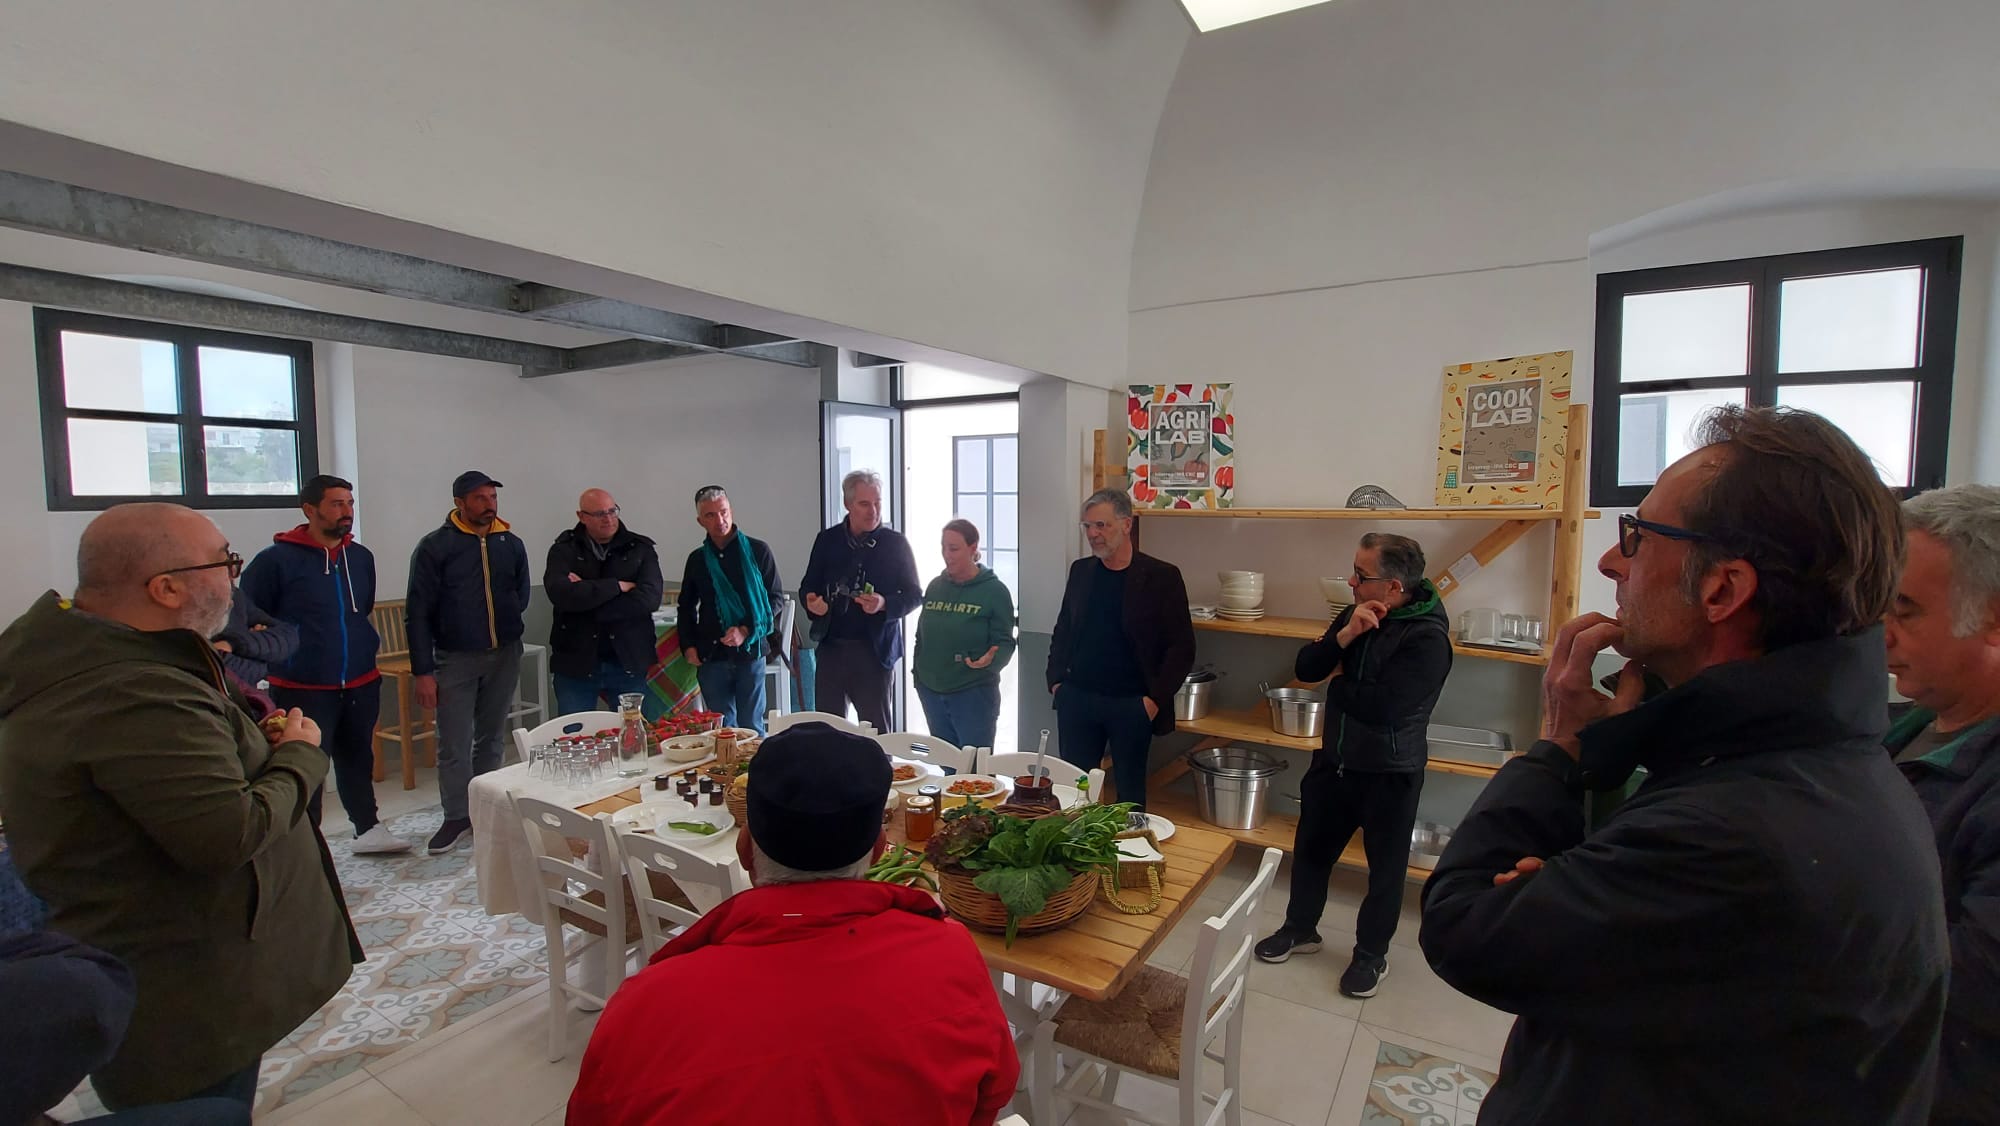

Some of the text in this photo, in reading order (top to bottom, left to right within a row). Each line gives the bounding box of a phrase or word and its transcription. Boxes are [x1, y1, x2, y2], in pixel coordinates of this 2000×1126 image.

[1473, 387, 1535, 411] COOK
[1156, 411, 1205, 429] AGRI
[1472, 407, 1532, 427] LAB
[1155, 431, 1205, 444] LAB
